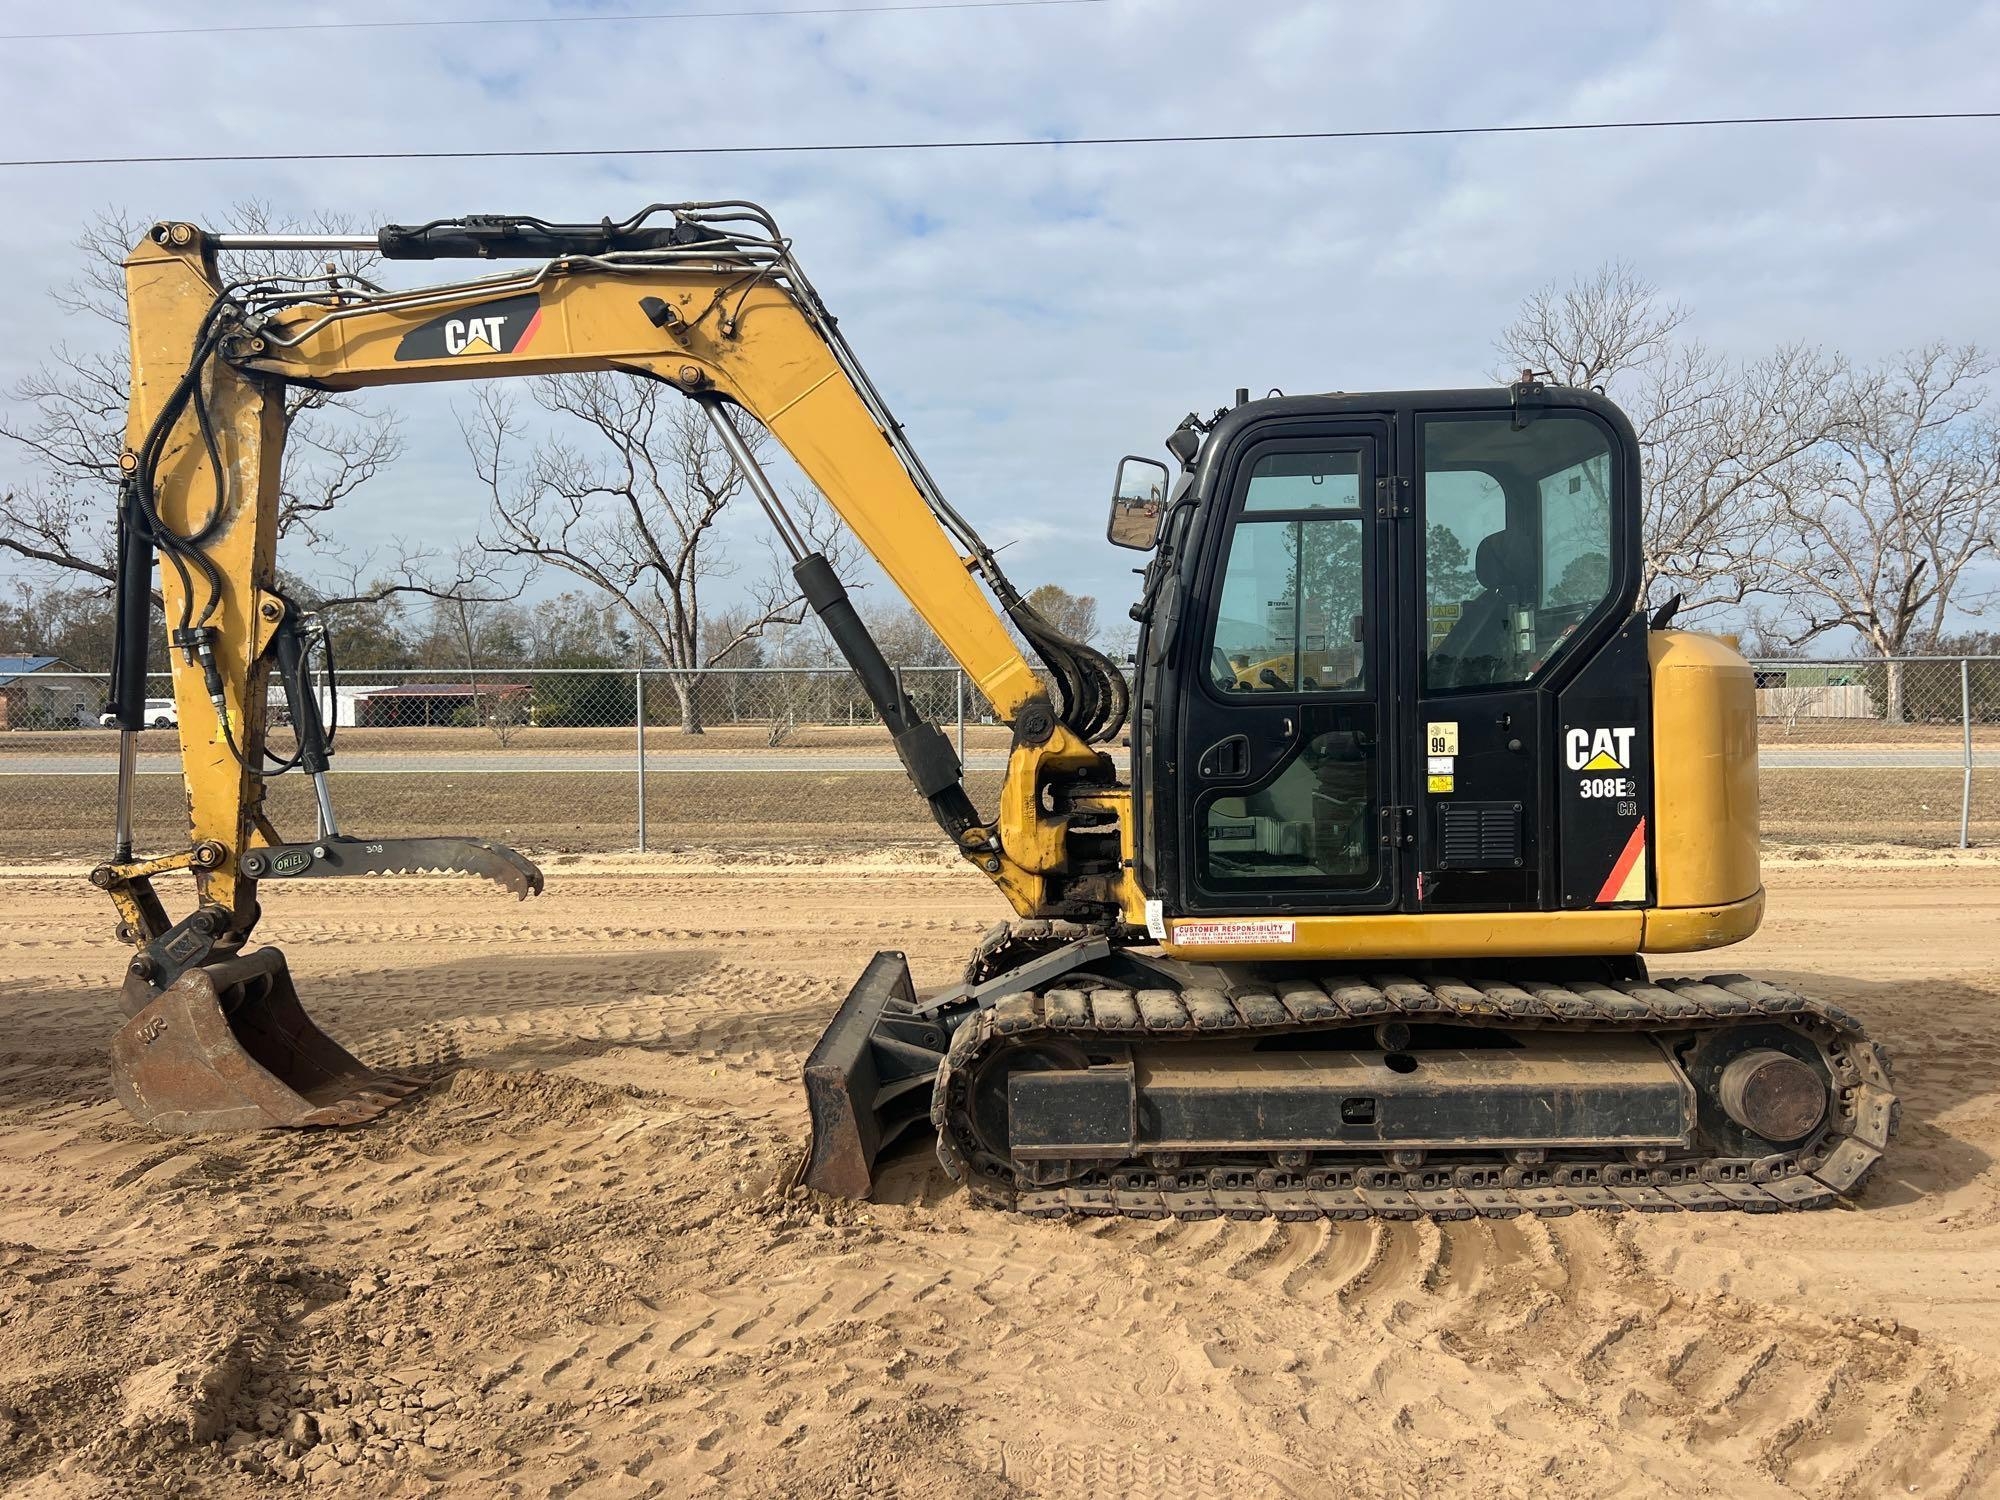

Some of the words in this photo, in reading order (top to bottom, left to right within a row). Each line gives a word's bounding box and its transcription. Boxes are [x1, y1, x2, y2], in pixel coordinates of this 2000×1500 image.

[445, 316, 504, 355] CAT
[1432, 737, 1445, 753] 99
[1566, 727, 1636, 771] CAT
[1580, 777, 1636, 798] 308E2
[1617, 800, 1637, 816] CR
[366, 844, 384, 853] 308
[277, 856, 303, 870] ORIEL
[1222, 924, 1283, 932] RESPONSIBILITY
